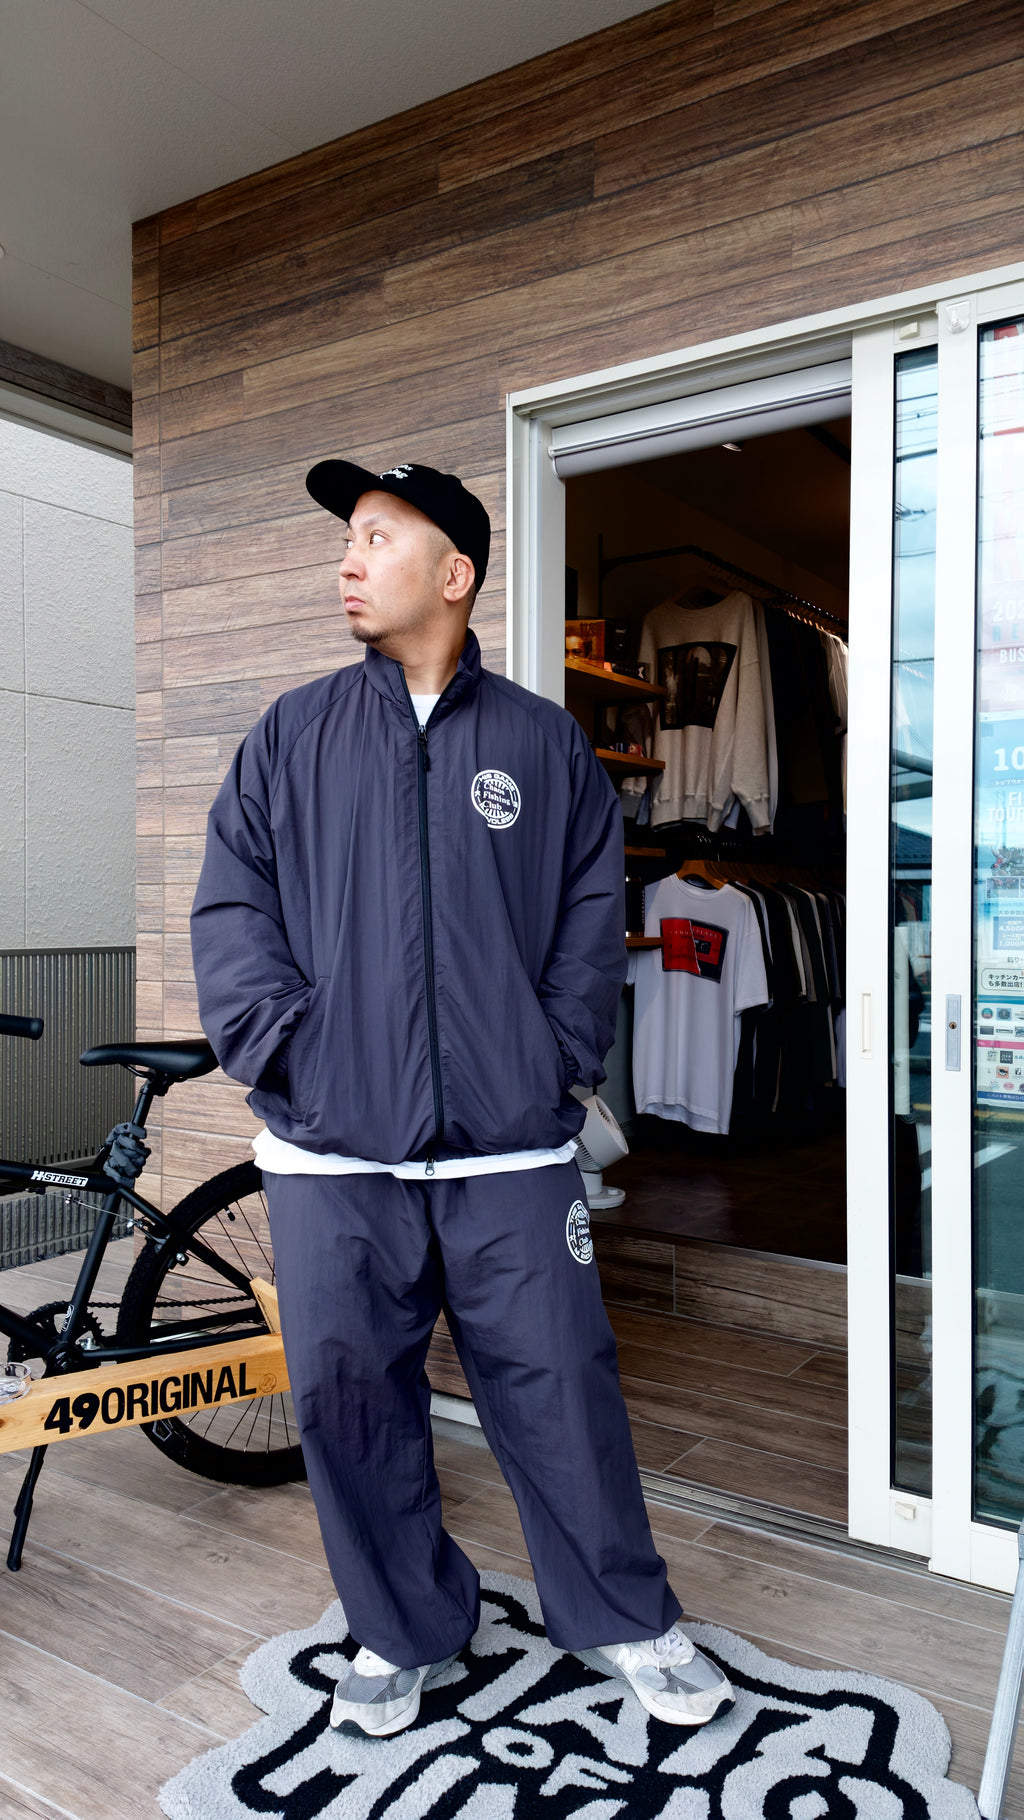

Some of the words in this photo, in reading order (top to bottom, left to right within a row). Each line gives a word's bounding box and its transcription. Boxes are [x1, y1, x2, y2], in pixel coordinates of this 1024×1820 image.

[493, 773, 516, 792] GAME
[483, 791, 511, 806] Fishing
[483, 800, 503, 811] Club
